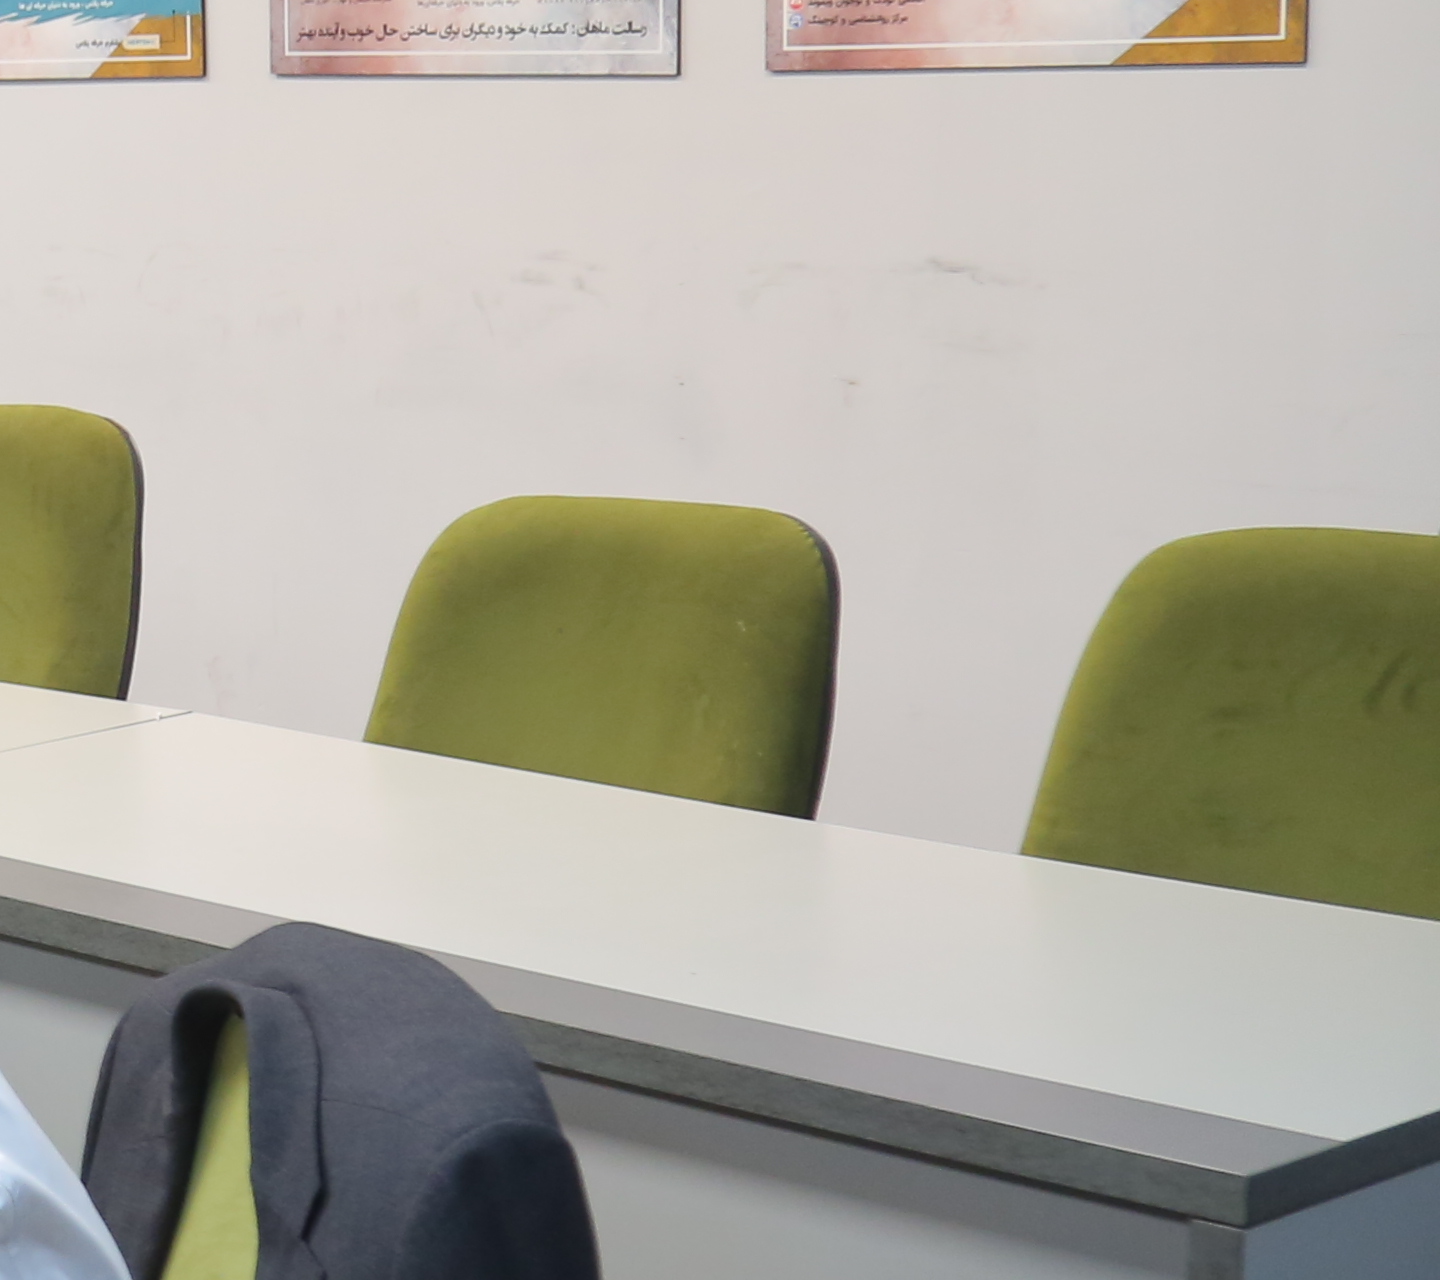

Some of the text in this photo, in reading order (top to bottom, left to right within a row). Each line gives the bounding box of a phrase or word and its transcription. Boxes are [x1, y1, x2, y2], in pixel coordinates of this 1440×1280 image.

[296, 27, 317, 43] بهتر
[317, 22, 340, 40] آینده
[339, 27, 346, 41] و
[347, 25, 375, 42] خوب
[375, 24, 398, 42] حال
[400, 22, 438, 41] ساختن
[439, 23, 461, 41] برای
[462, 23, 496, 41] دیگران
[495, 25, 503, 40] و
[504, 23, 527, 41] خود
[528, 24, 539, 38] به
[540, 22, 570, 35] کمک
[612, 21, 648, 38] رسالت
